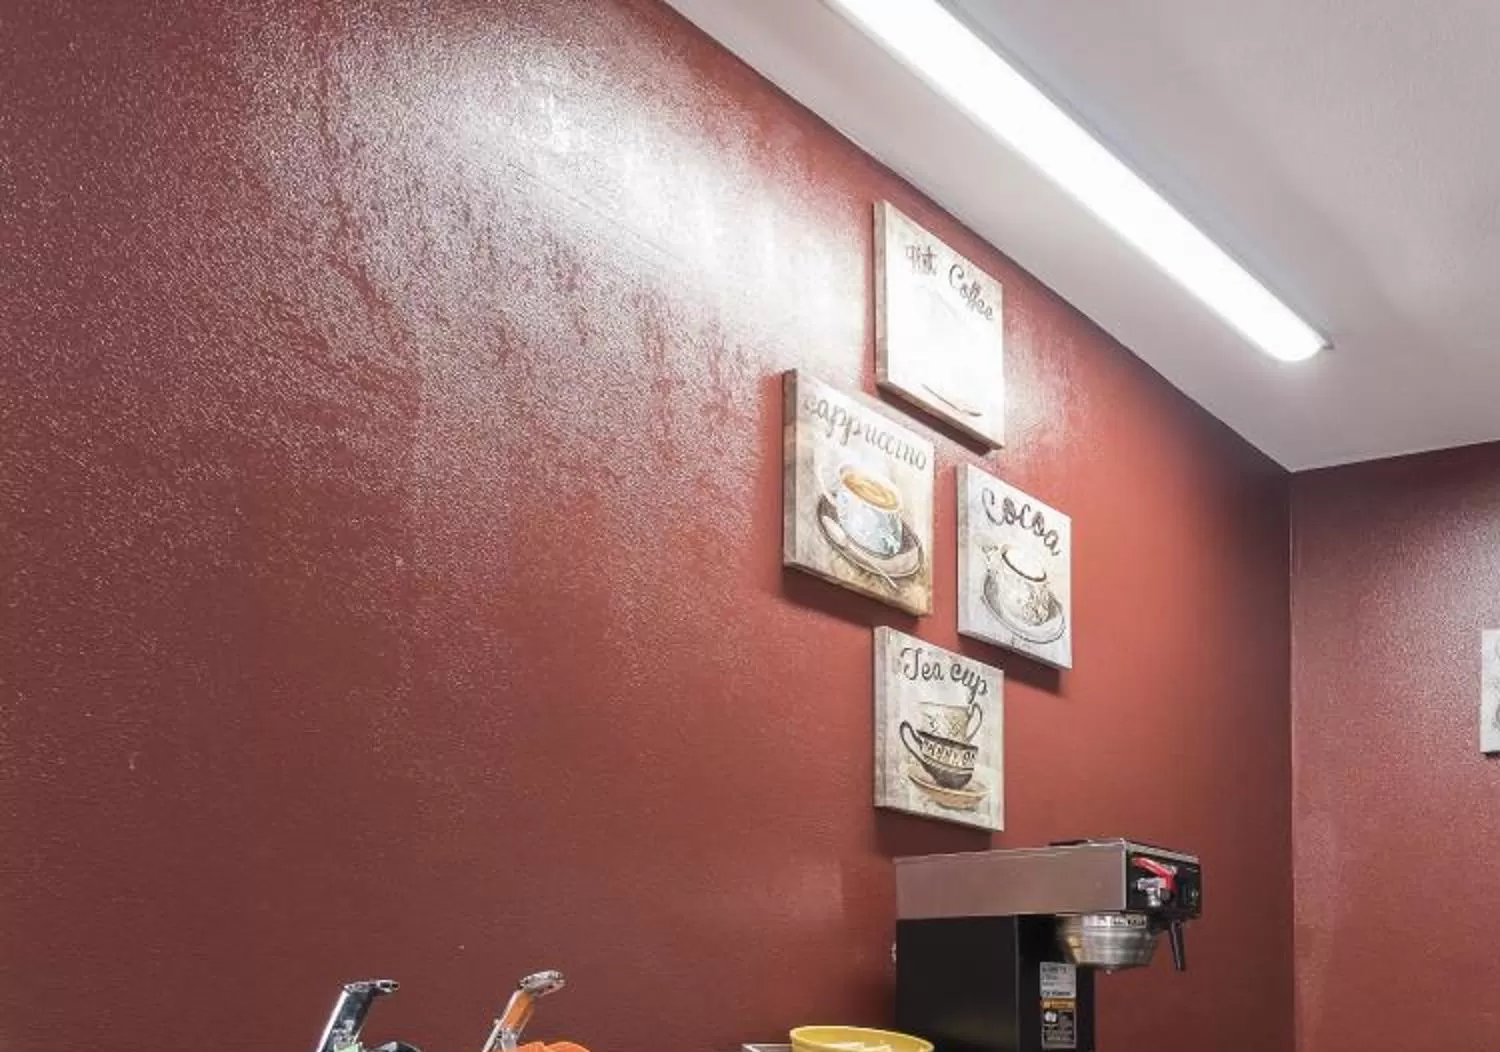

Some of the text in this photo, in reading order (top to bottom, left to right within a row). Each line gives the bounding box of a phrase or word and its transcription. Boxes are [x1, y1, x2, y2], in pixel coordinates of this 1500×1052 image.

[948, 262, 994, 321] Coffee
[981, 486, 1062, 557] Cocoa
[899, 646, 945, 682] Tea
